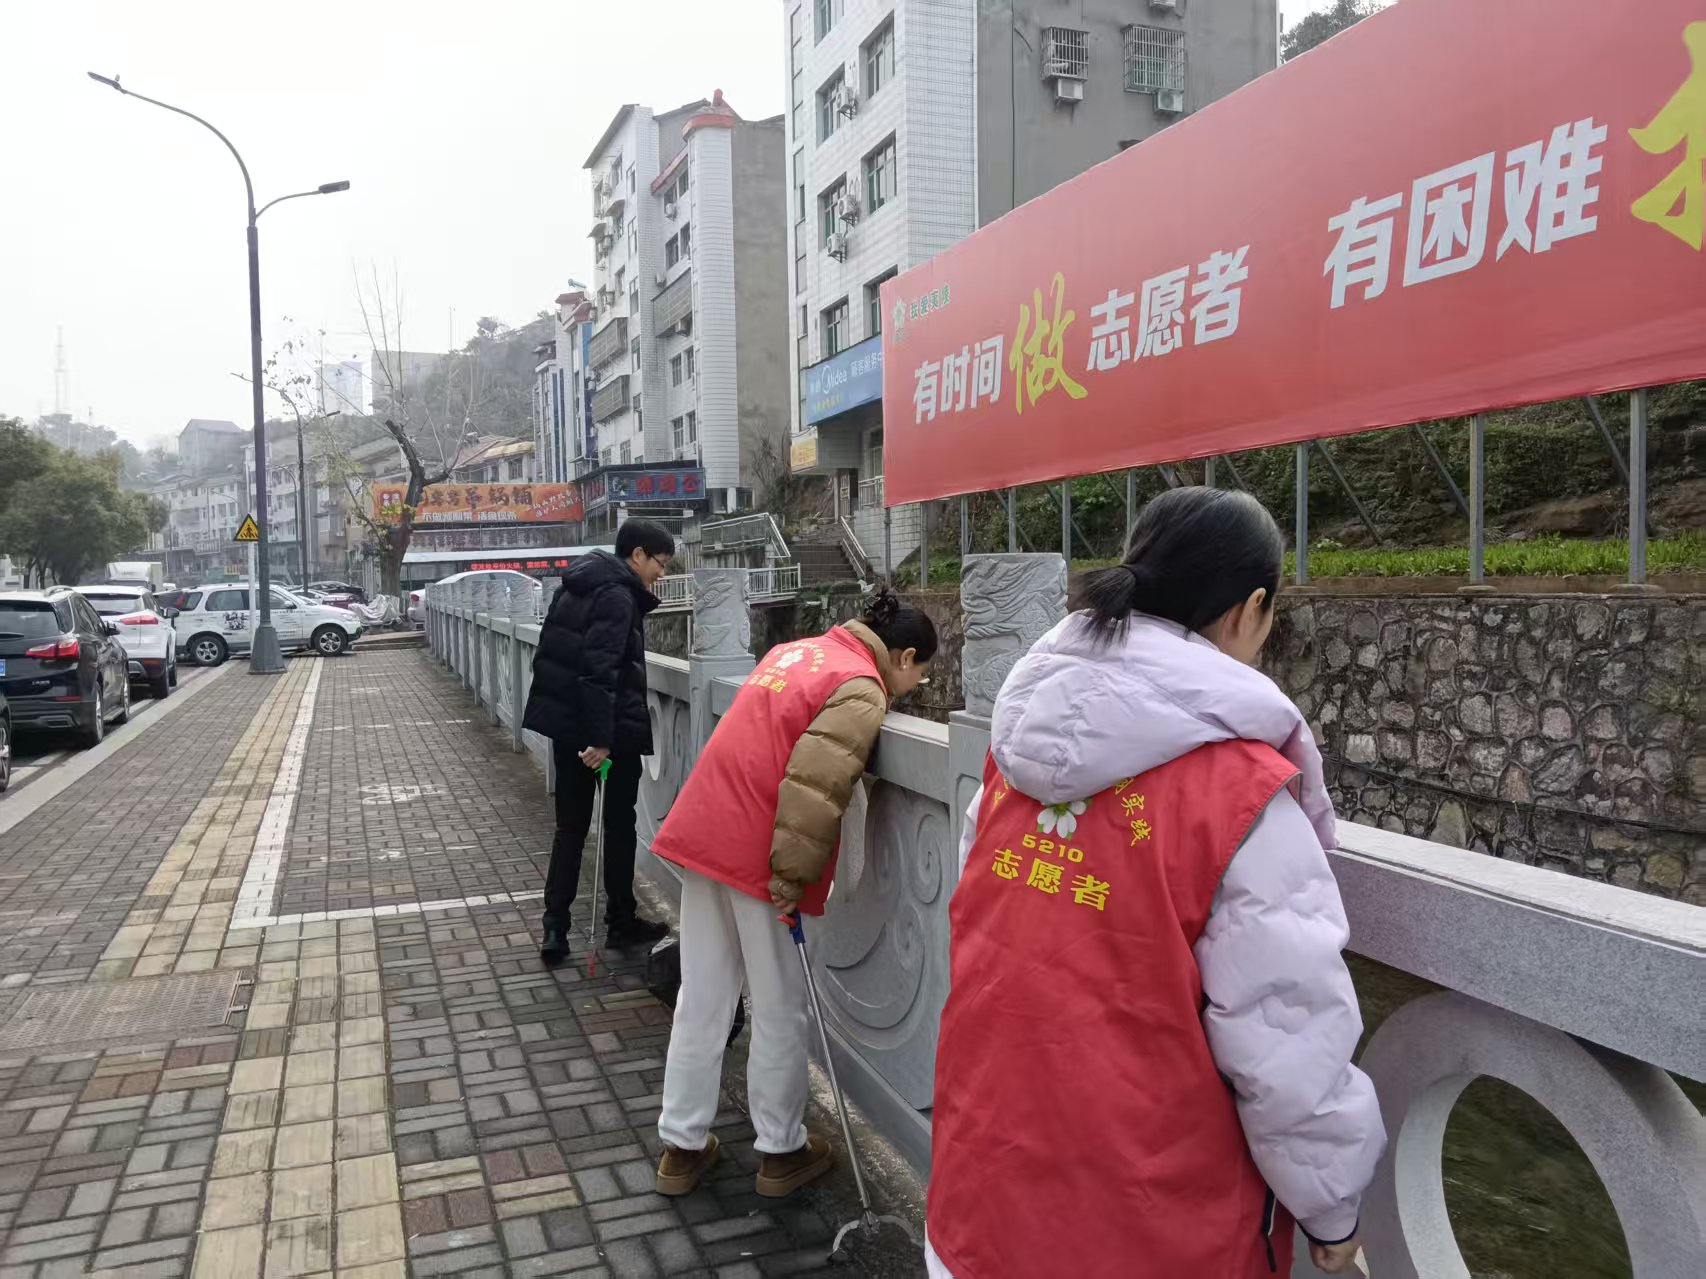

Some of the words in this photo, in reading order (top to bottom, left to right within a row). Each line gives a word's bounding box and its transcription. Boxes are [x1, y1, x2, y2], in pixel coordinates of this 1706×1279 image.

[913, 244, 1251, 425] 有时间做志愿者
[822, 364, 848, 394] Midea
[1022, 833, 1085, 863] 5210
[991, 848, 1111, 912] 志愿者
